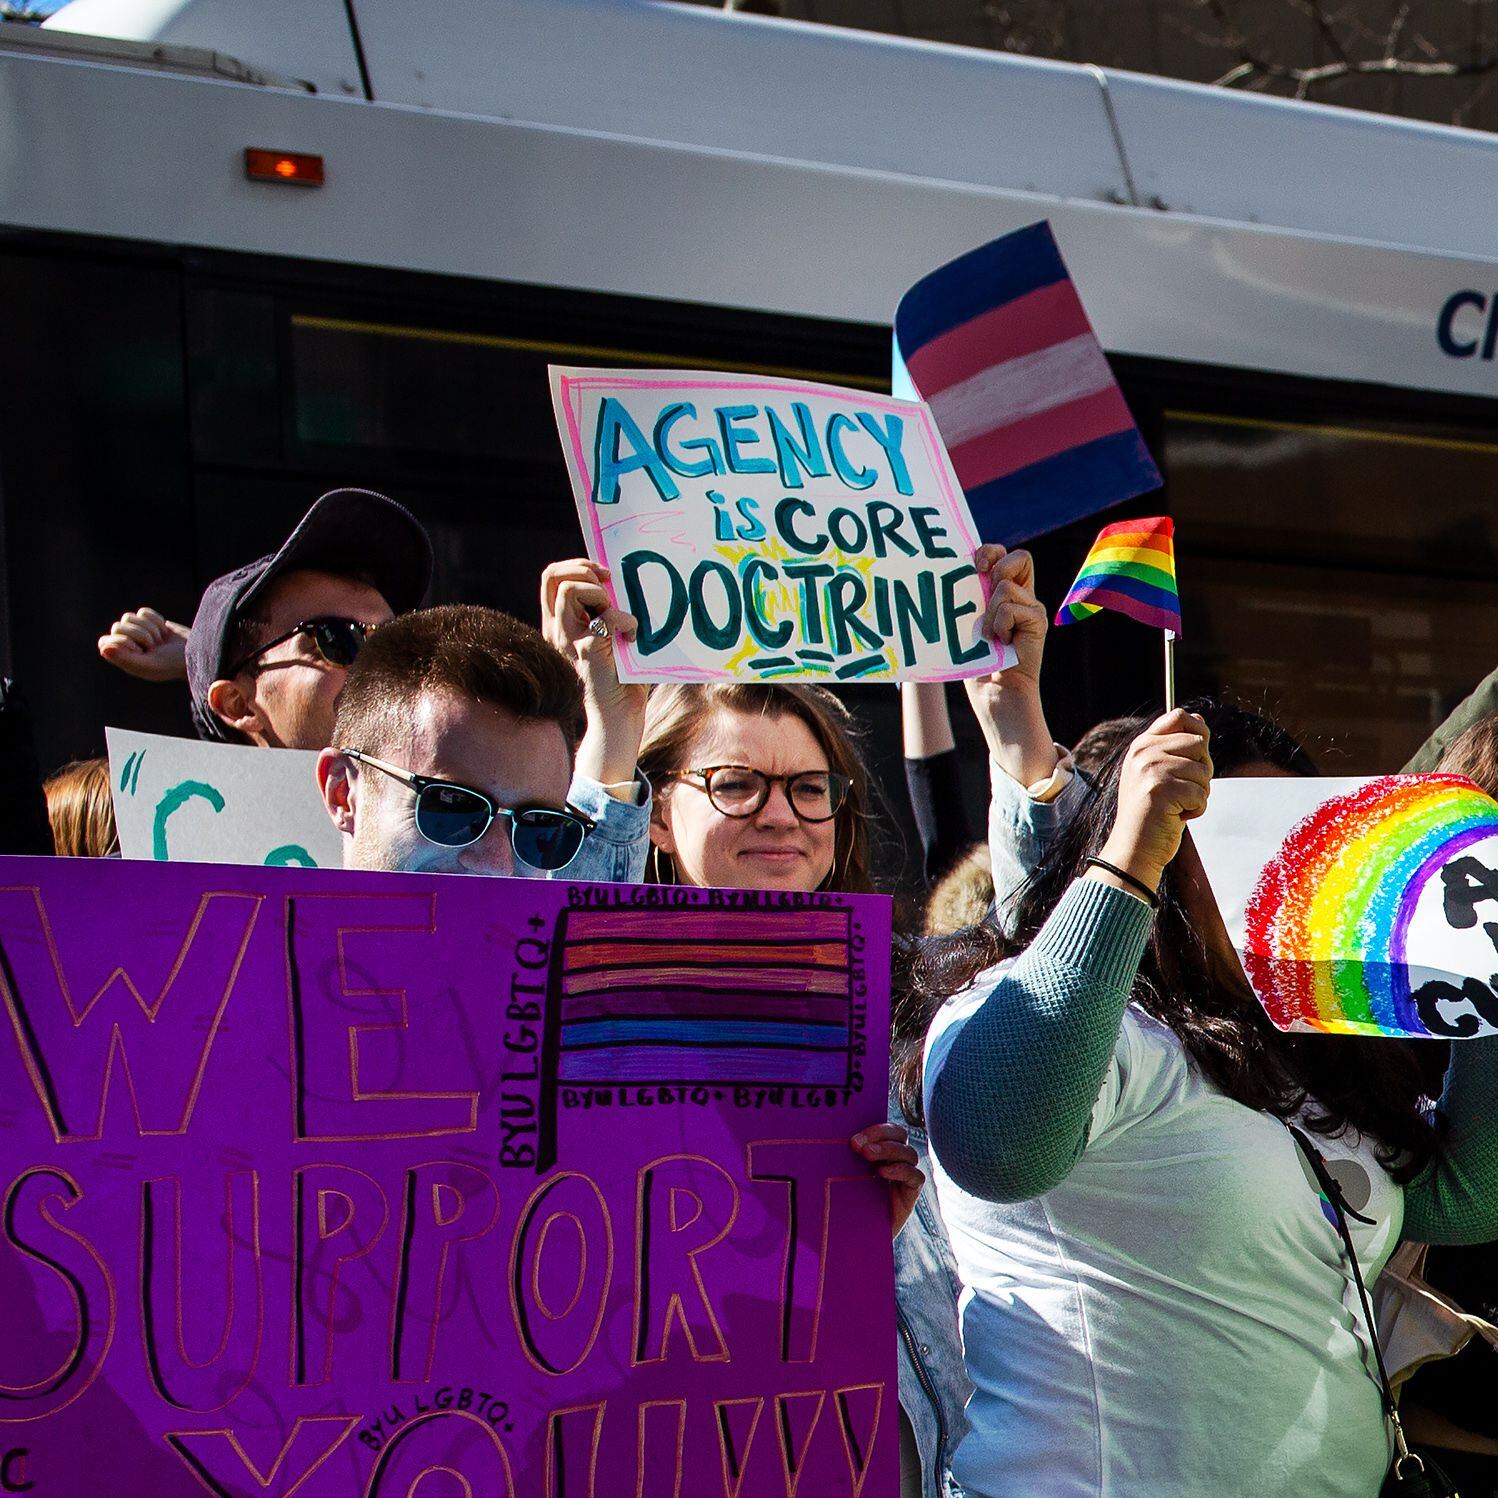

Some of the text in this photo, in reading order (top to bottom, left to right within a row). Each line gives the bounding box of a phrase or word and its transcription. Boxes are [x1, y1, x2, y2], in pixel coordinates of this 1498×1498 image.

[591, 396, 917, 504] AGENCY
[705, 489, 957, 559] is CORE
[620, 549, 990, 667] DOCTRINE
[0, 886, 480, 1143] WE
[0, 1139, 878, 1422] SUPPORT
